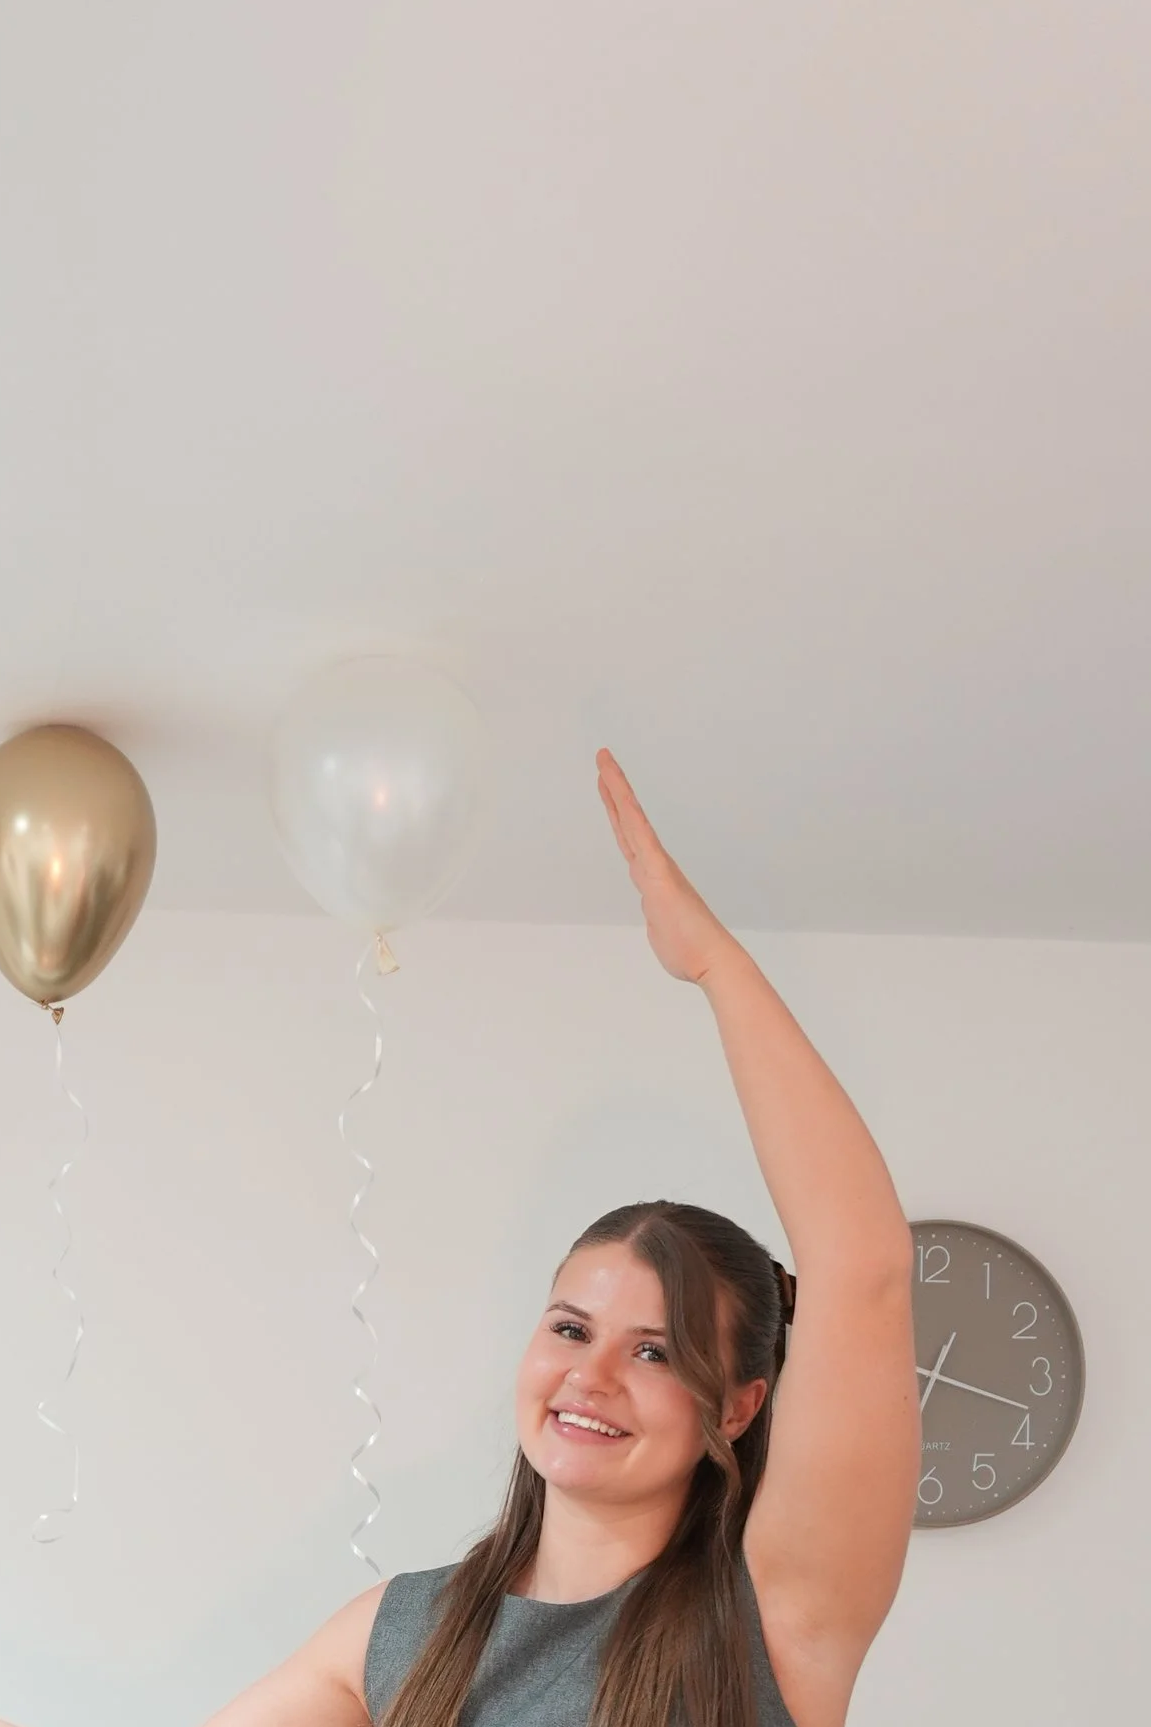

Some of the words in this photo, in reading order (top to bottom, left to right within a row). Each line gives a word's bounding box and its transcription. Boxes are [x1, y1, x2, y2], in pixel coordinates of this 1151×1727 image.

[916, 1245, 951, 1284] 12
[982, 1262, 990, 1300] 1
[1011, 1301, 1038, 1340] 2
[1029, 1356, 1053, 1396] 3
[1010, 1412, 1036, 1450] 4
[917, 1466, 943, 1504] 6
[971, 1453, 996, 1490] 5
